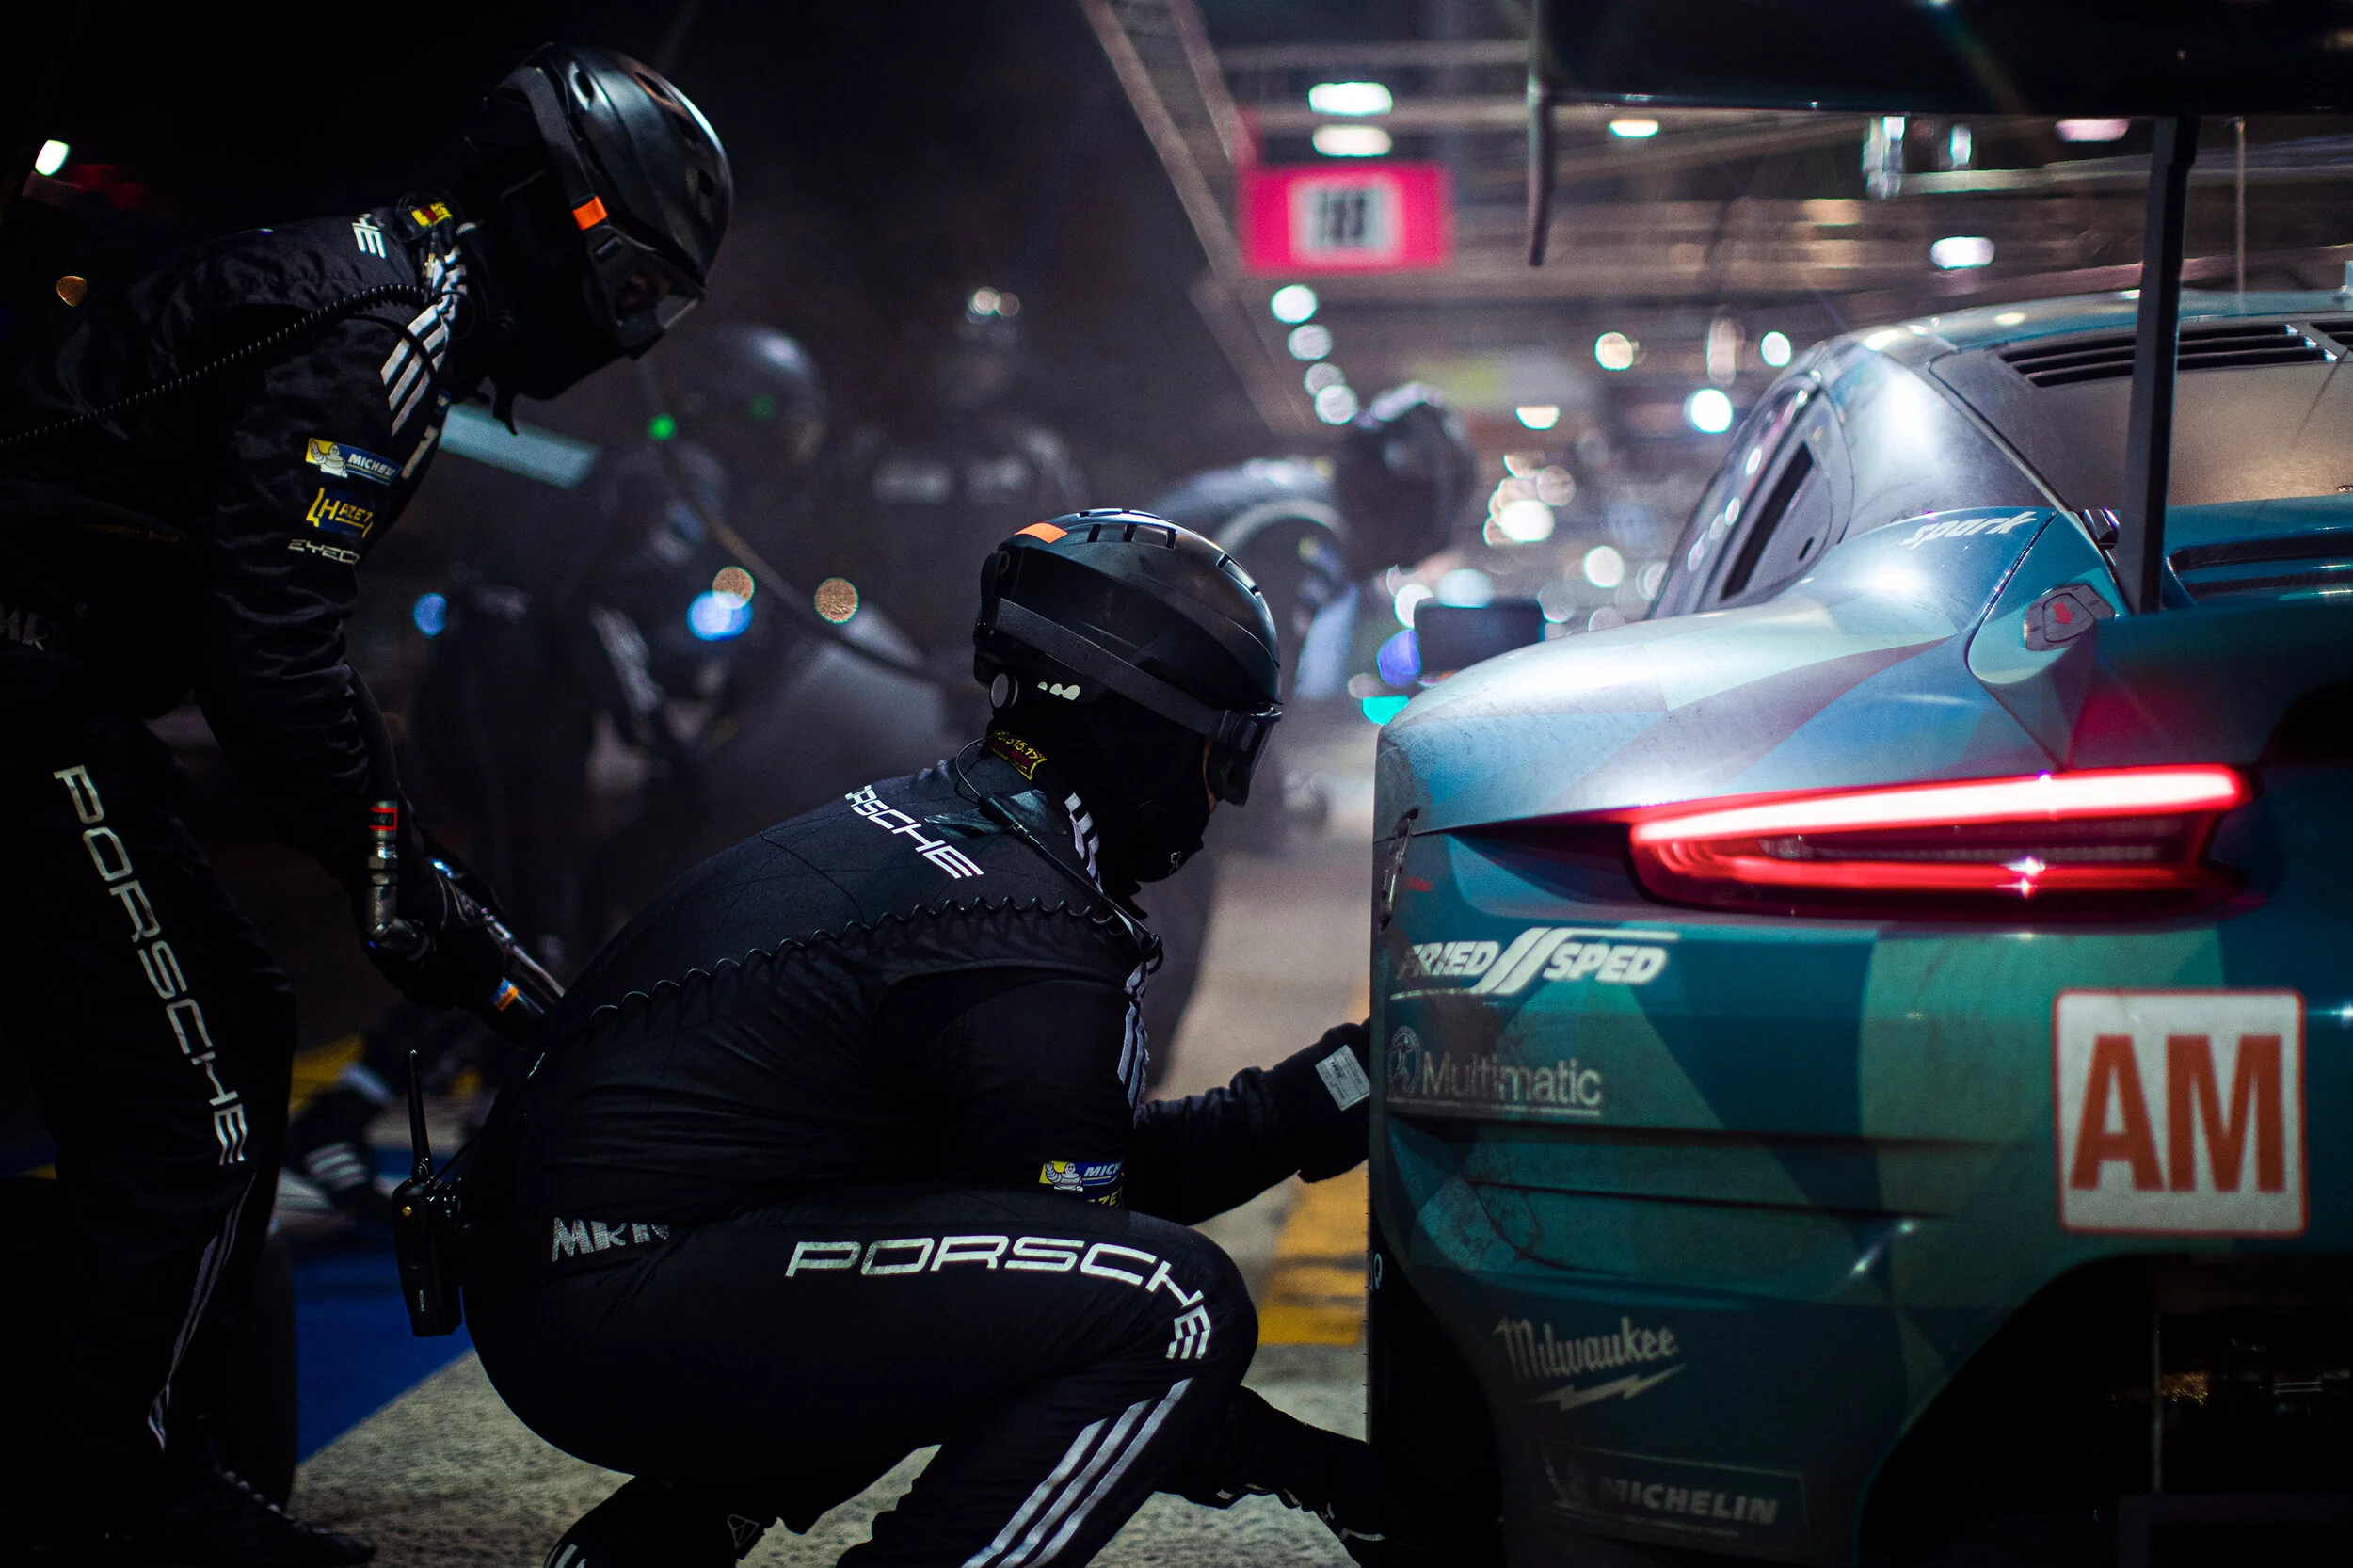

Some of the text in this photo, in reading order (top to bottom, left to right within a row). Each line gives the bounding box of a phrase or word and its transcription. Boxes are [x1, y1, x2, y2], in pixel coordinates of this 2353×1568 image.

[1899, 511, 2037, 550] spark
[54, 764, 248, 1167] PORSCHE
[1542, 942, 1669, 985] SPED
[1420, 1050, 1602, 1107] Multimatic
[2072, 1034, 2286, 1193] AM
[784, 1234, 1211, 1361] PORSCHE
[1491, 1314, 1680, 1382] Milwaukee
[1601, 1475, 1779, 1526] MICHELIN
